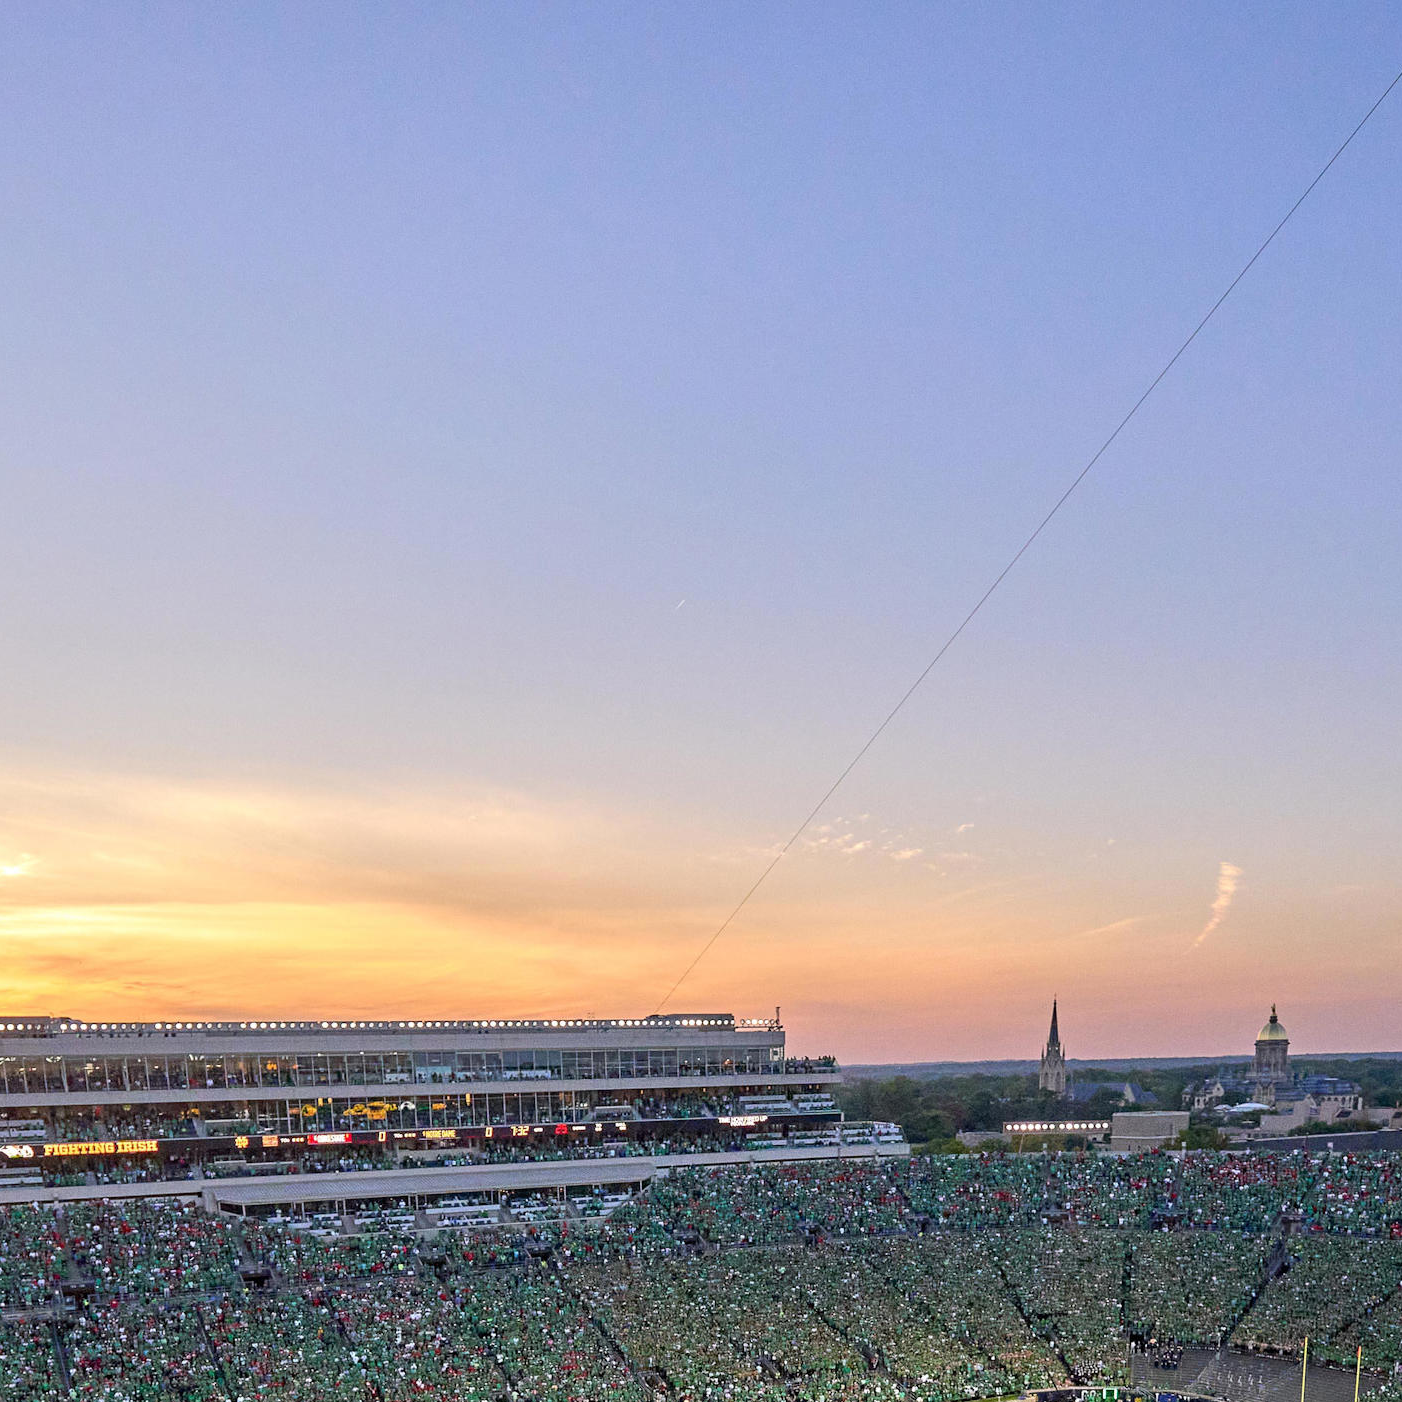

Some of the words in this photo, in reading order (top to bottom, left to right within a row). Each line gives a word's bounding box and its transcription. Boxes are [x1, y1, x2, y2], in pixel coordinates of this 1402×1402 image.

[511, 1126, 529, 1136] 7:32
[44, 1142, 115, 1156] FIGHTING
[117, 1140, 158, 1153] IRISH
